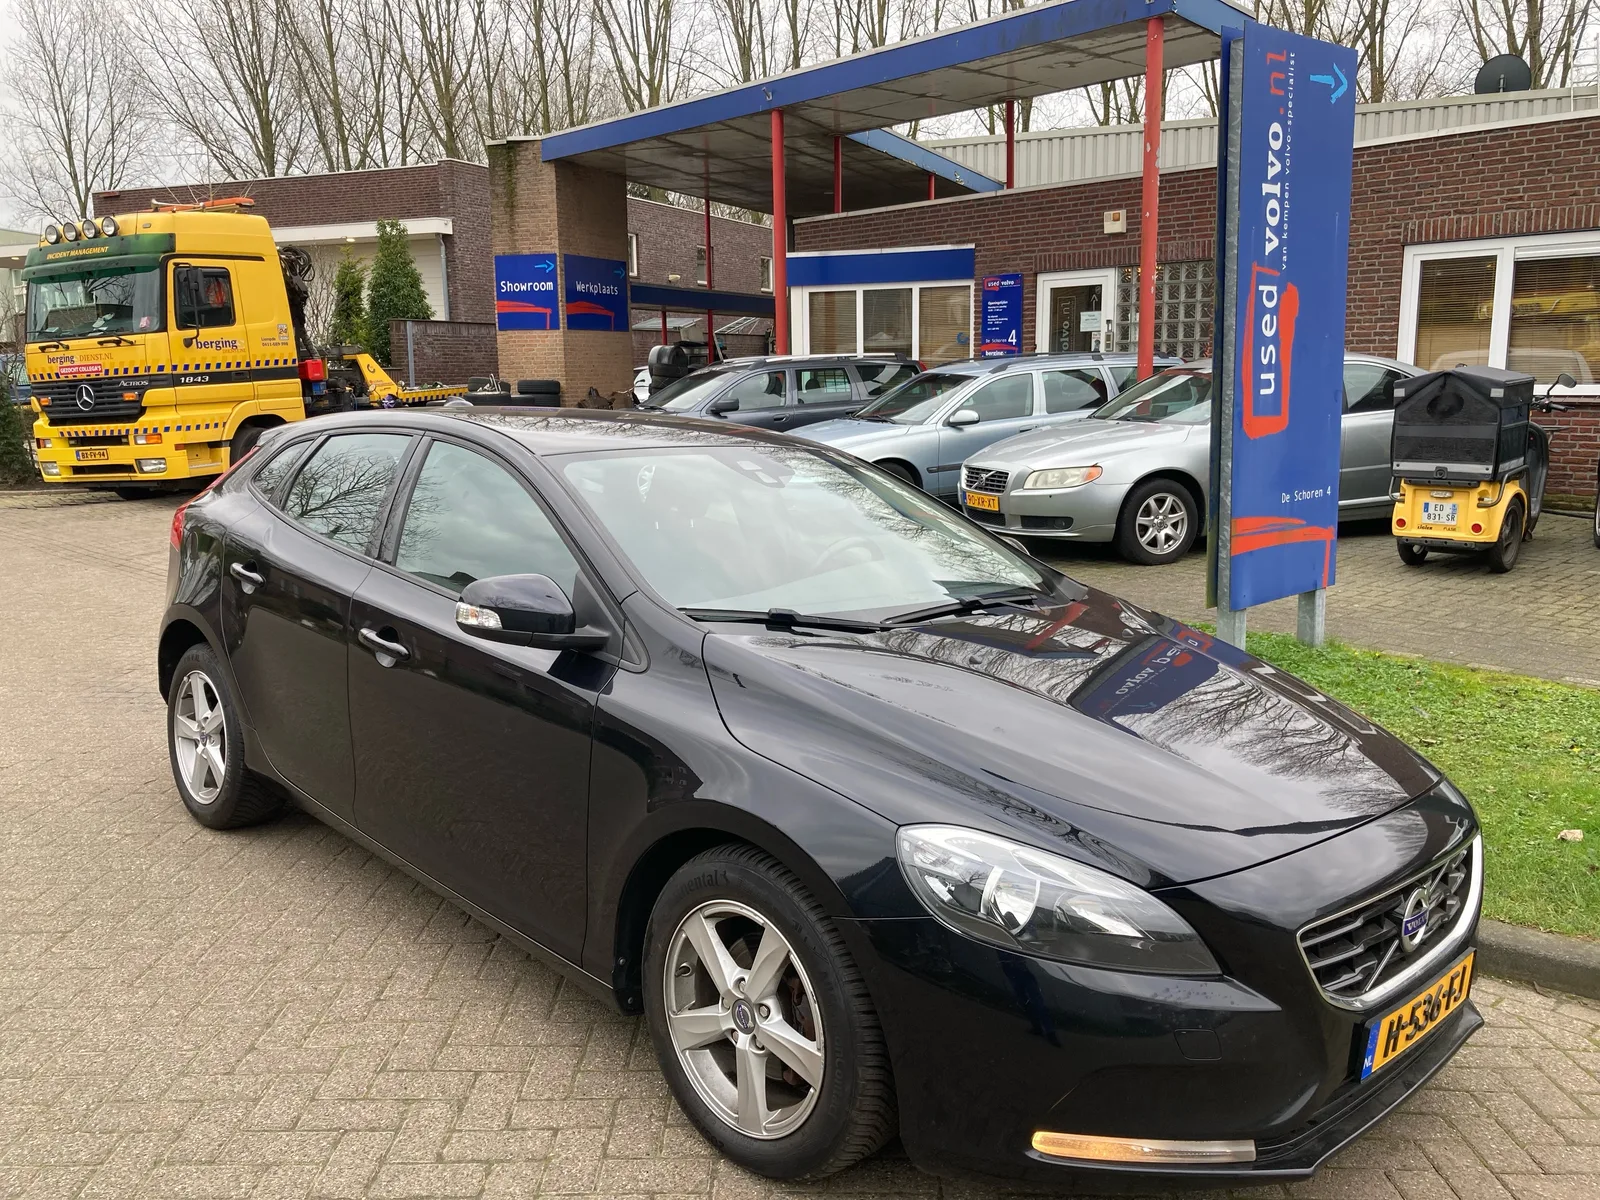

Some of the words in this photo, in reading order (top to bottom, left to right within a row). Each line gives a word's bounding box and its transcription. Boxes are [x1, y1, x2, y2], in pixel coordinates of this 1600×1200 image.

[1284, 51, 1296, 175] volvo-specialist
[1262, 50, 1287, 256] volvo.nl
[1282, 182, 1290, 240] kempen
[46, 250, 70, 260] INCIDENT
[70, 246, 109, 257] MANAGEMENT
[500, 280, 554, 293] Showroom
[575, 280, 619, 296] Werkplaats
[1060, 301, 1070, 352] olvo.nl
[196, 337, 238, 351] berging
[1008, 330, 1017, 345] 4
[1258, 284, 1278, 396] used
[47, 353, 75, 365] berging
[79, 353, 114, 362] DIENST.NL
[60, 366, 79, 374] GEZOCHT
[180, 375, 209, 384] 1843
[967, 494, 996, 509] 90-XR-XT
[1281, 493, 1291, 504] De
[1294, 488, 1324, 502] Schoren
[1326, 486, 1331, 496] 4
[1383, 964, 1467, 1058] H-536-FJ
[1362, 1057, 1373, 1071] NL
